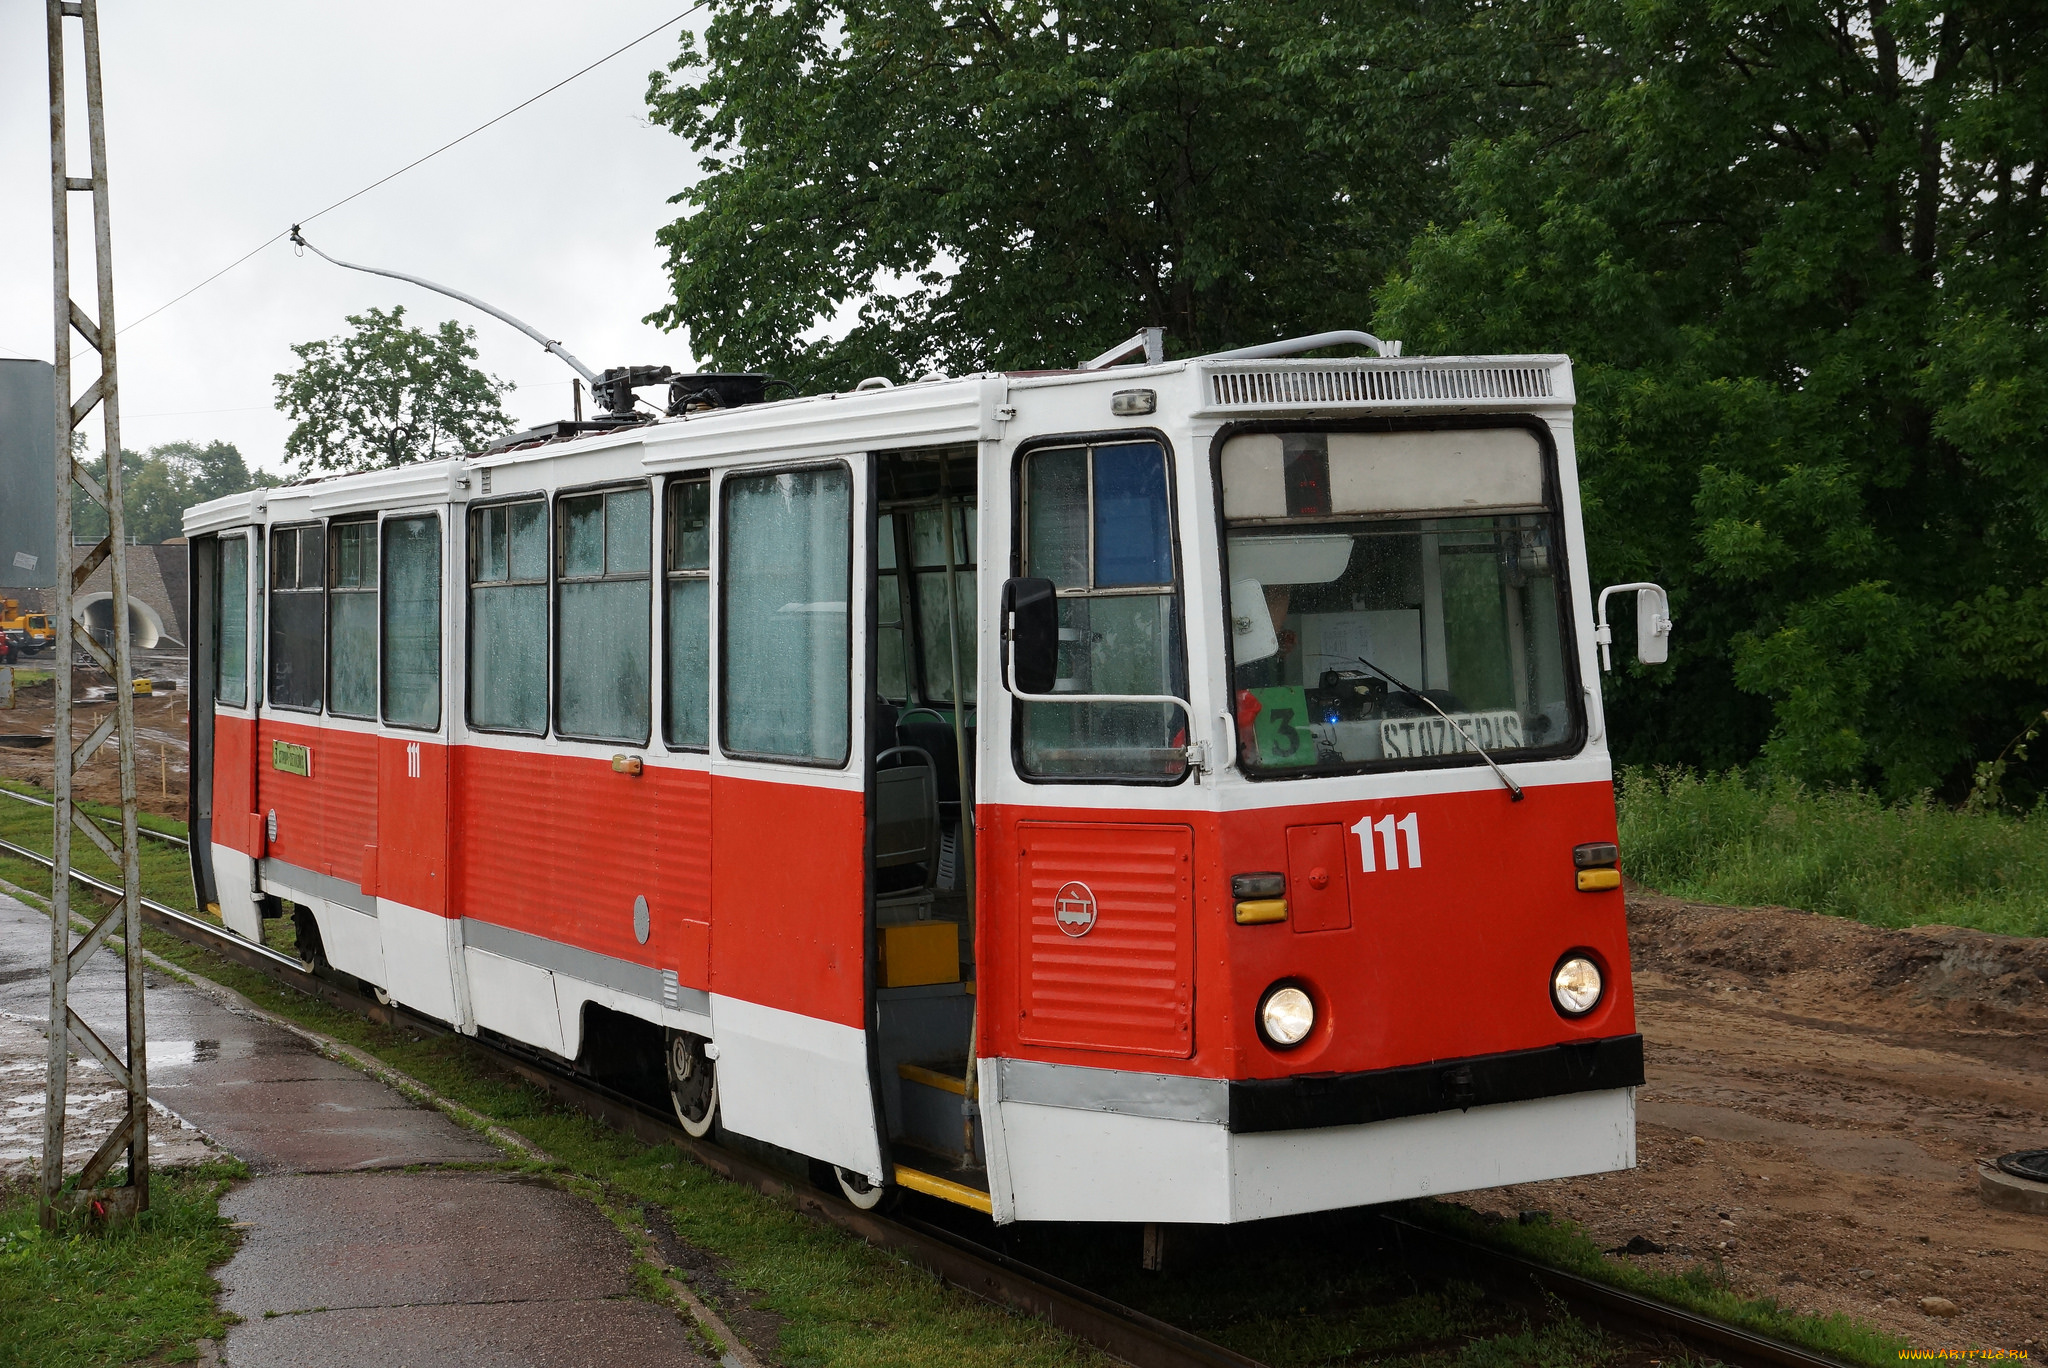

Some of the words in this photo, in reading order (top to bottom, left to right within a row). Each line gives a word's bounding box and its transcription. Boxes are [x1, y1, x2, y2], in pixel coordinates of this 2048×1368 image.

[1270, 708, 1300, 757] 3
[406, 742, 420, 778] 111
[1350, 812, 1422, 873] 111
